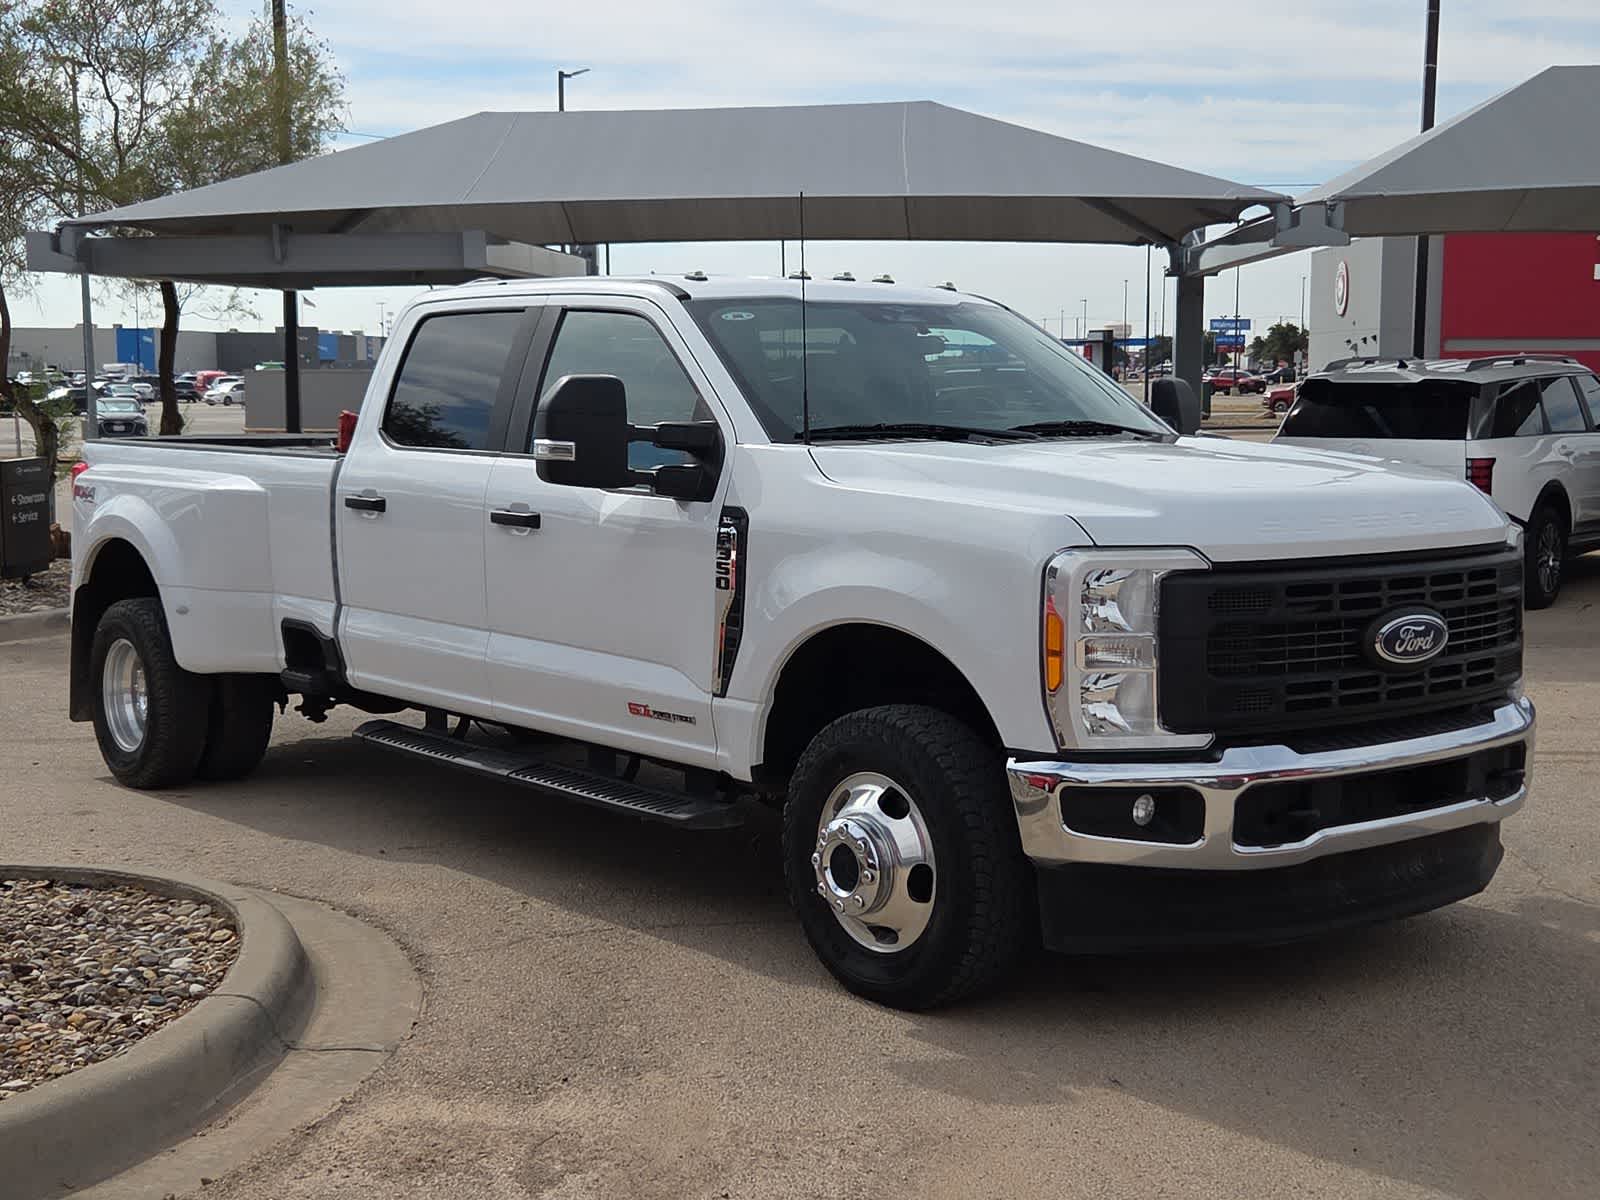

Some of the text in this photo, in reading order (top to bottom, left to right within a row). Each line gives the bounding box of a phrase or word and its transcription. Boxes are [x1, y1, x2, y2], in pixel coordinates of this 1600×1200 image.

[16, 494, 45, 505] Showroom
[17, 511, 39, 523] Service
[1395, 625, 1434, 653] Ford
